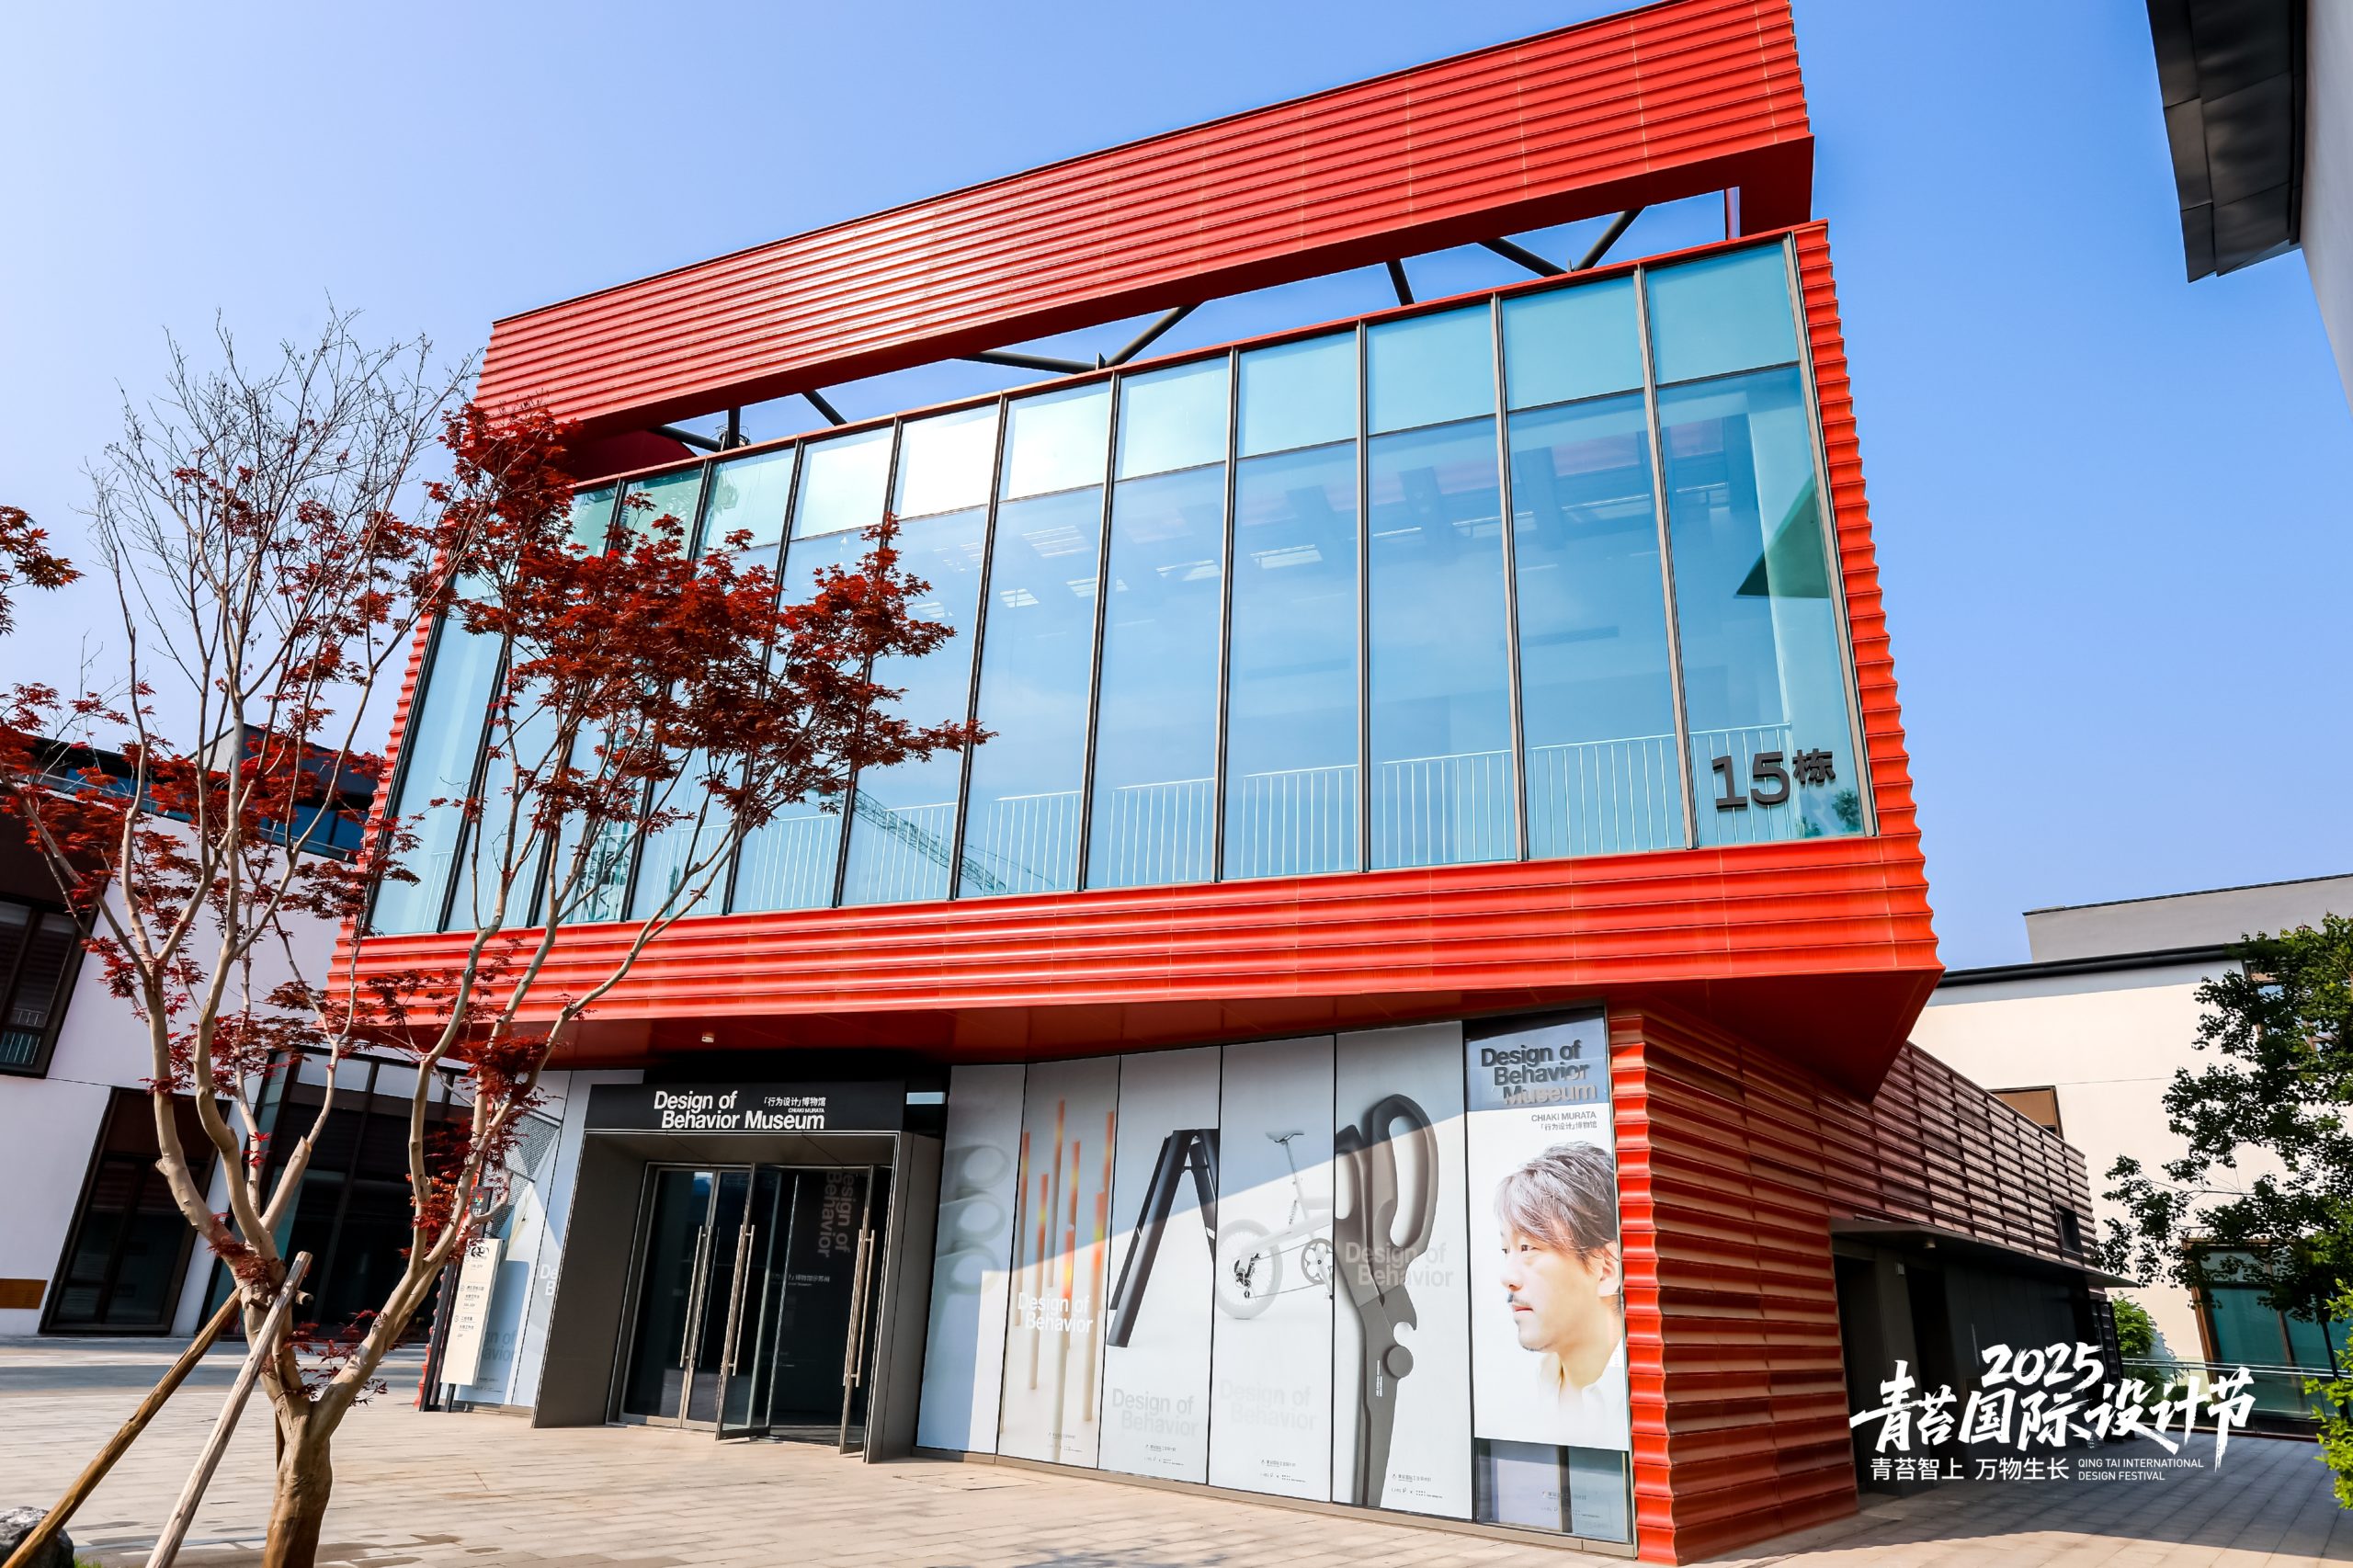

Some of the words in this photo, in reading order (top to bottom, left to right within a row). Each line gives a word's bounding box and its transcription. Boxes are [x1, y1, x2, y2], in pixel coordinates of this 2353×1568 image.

[1712, 748, 1836, 809] 15栋
[1481, 1044, 1554, 1068] Design
[1560, 1040, 1583, 1060] of
[1494, 1062, 1591, 1086] Behavior
[654, 1090, 713, 1114] Design
[718, 1090, 738, 1109] of
[1503, 1084, 1597, 1105] Museum
[662, 1110, 740, 1130] Behavior
[745, 1110, 825, 1130] Museum
[1531, 1112, 1560, 1122] CHIAKI
[1562, 1111, 1597, 1120] MURATA
[835, 1175, 857, 1226] esign
[1345, 1242, 1418, 1268] Design
[1427, 1243, 1447, 1264] of
[1358, 1265, 1454, 1288] Behavior
[1017, 1292, 1069, 1316] Design
[1074, 1295, 1090, 1313] of
[1025, 1312, 1093, 1334] Behavior
[1112, 1388, 1170, 1416] Design
[1176, 1395, 1195, 1415] of
[1222, 1379, 1286, 1408] Design
[1292, 1385, 1312, 1406] of
[1121, 1410, 1199, 1437] Behavior
[1231, 1401, 1318, 1431] Behavior
